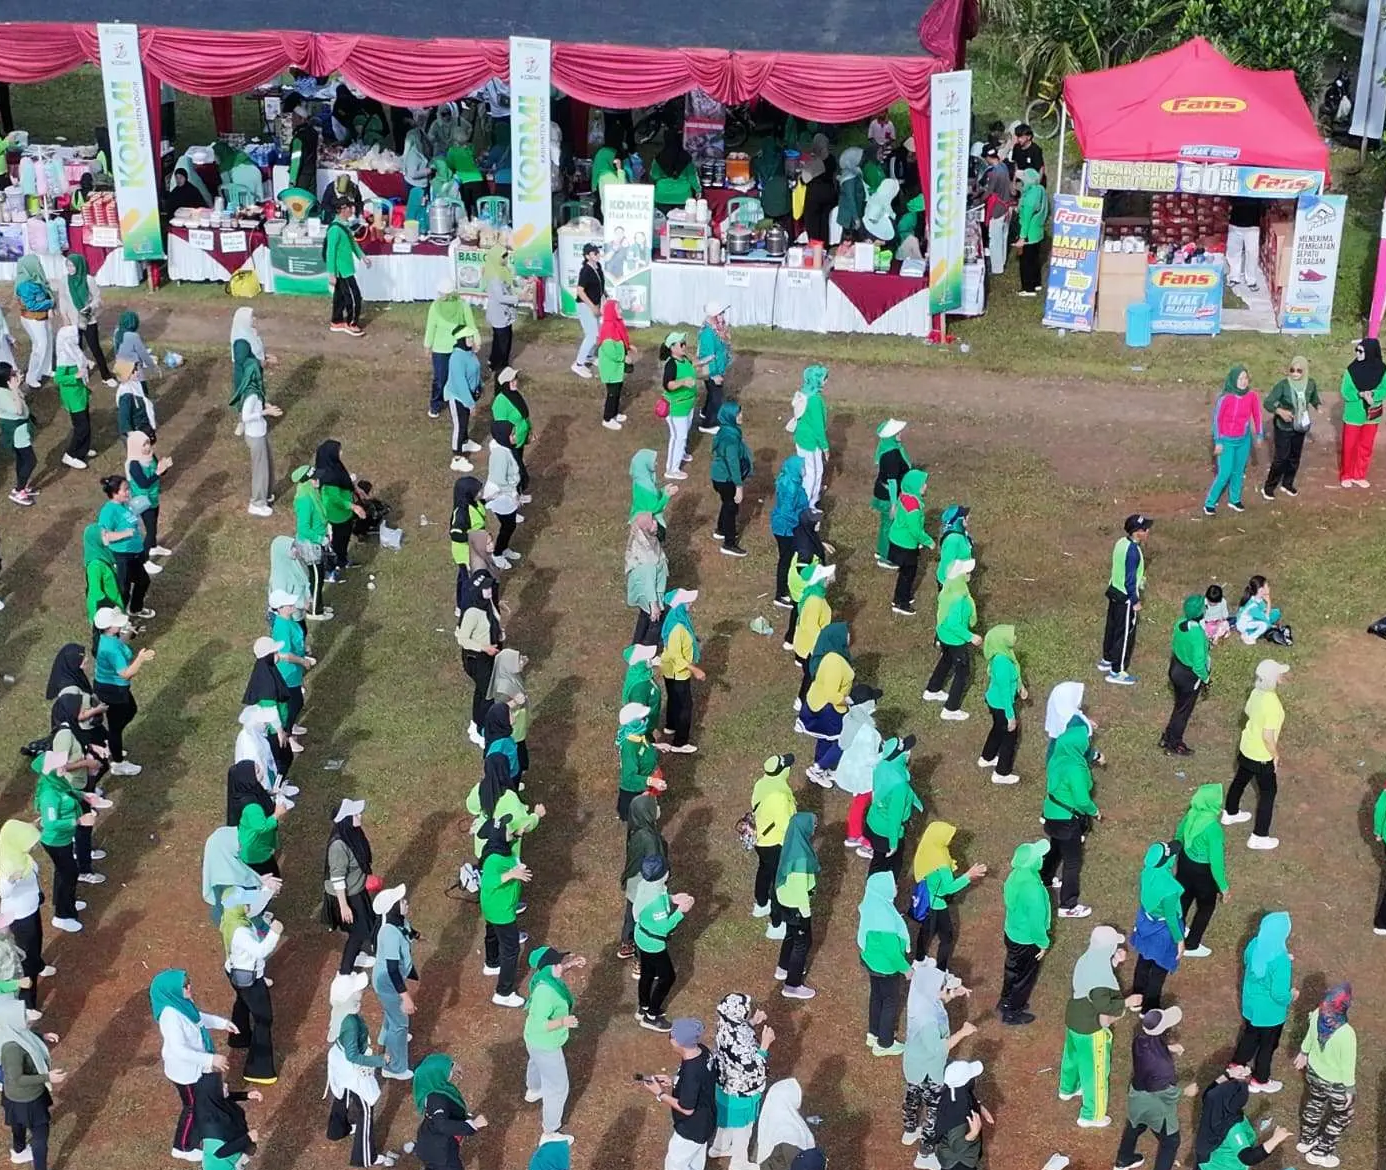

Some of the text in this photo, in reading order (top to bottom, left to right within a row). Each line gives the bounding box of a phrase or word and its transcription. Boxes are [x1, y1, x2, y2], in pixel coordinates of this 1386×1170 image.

[1172, 99, 1236, 111] Fans
[111, 81, 147, 188] KORMI
[517, 95, 547, 202] KORMI
[934, 130, 960, 239] KORMI
[1182, 166, 1220, 192] 50
[1252, 174, 1310, 191] Fans
[1055, 208, 1100, 226] Fans
[1159, 271, 1210, 286] Fans
